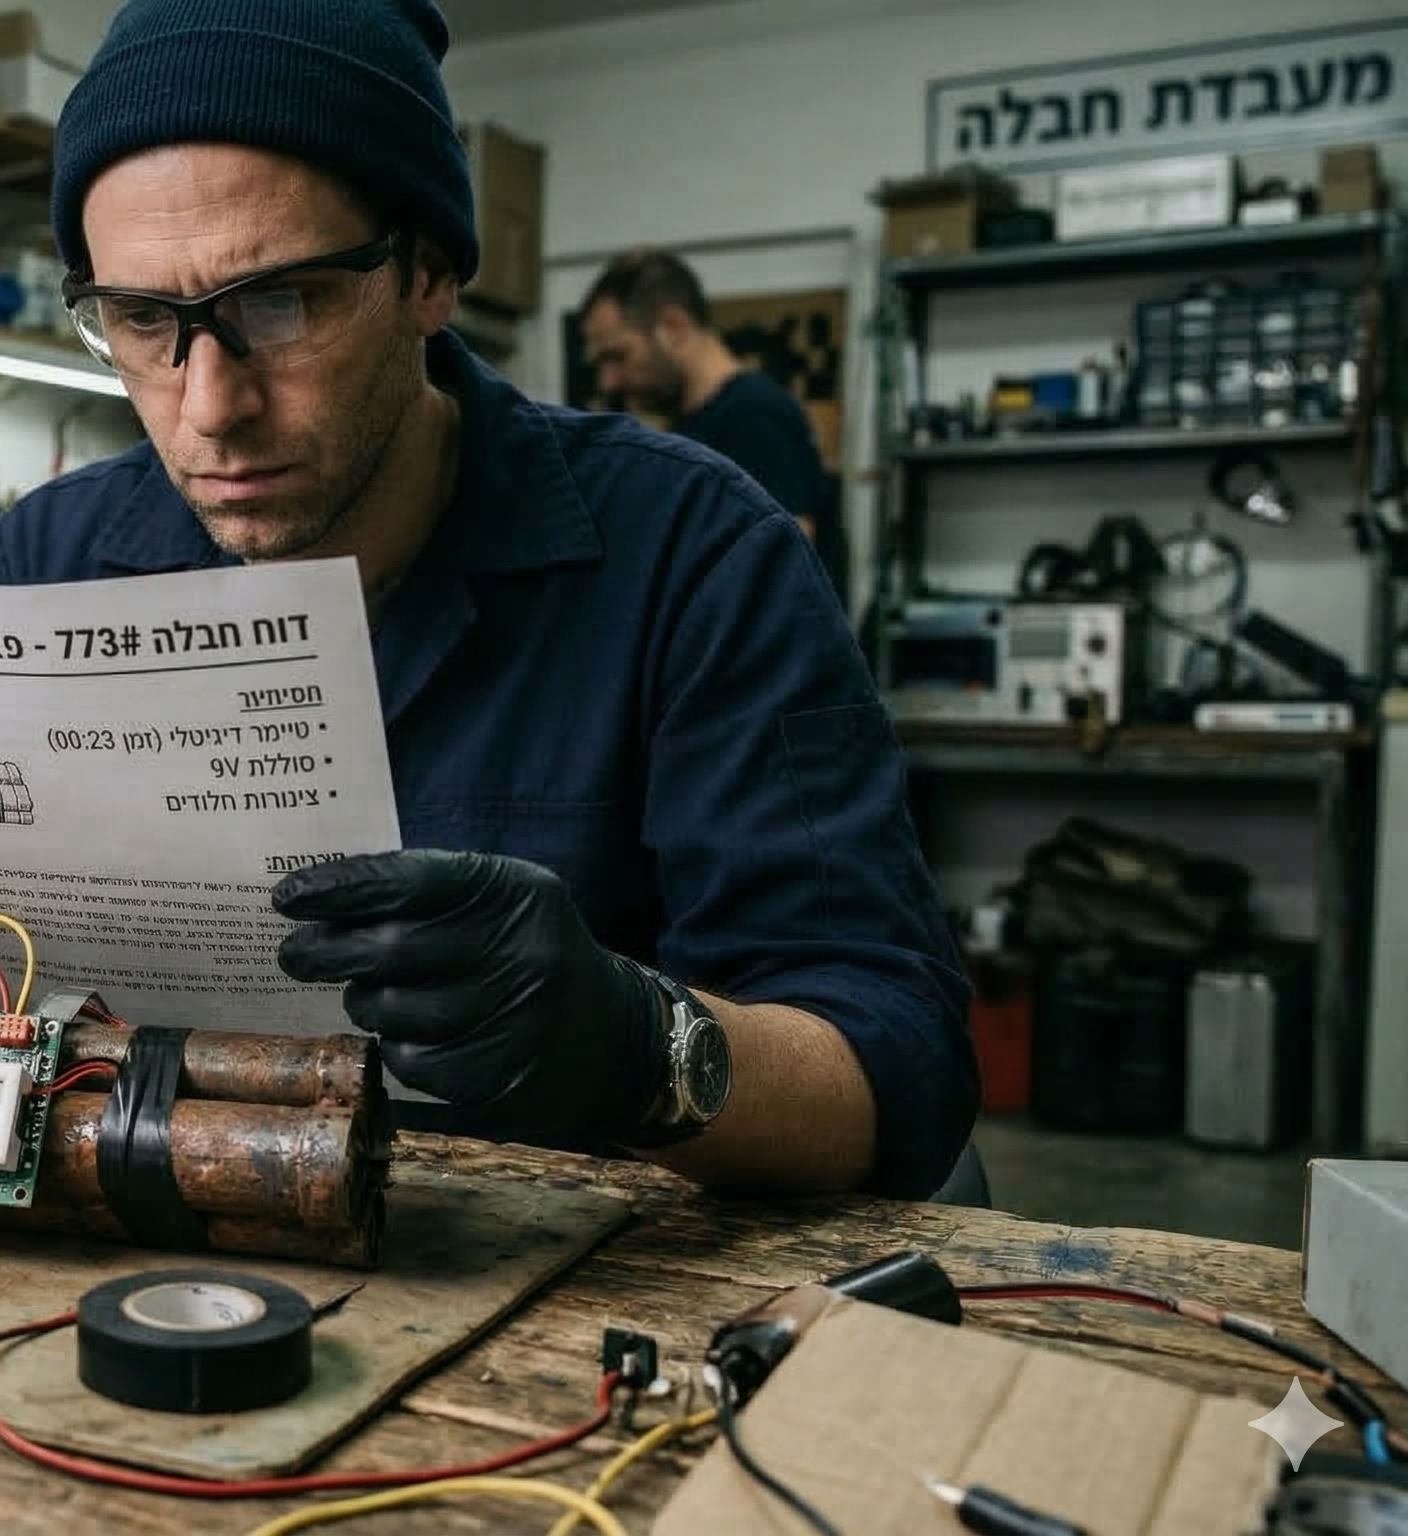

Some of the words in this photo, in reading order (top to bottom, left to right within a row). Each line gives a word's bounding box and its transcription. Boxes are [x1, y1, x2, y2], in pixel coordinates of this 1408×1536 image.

[1147, 51, 1393, 131] מעבדת
[956, 86, 1122, 150] חבלה
[152, 620, 241, 654] חבלה
[252, 614, 308, 645] דוח
[170, 726, 241, 748] דיגיטלי
[250, 720, 309, 743] טיימר
[210, 757, 239, 778] 9V
[248, 753, 315, 777] סוללת
[166, 791, 236, 812] חלודים
[244, 787, 320, 810] צינורות
